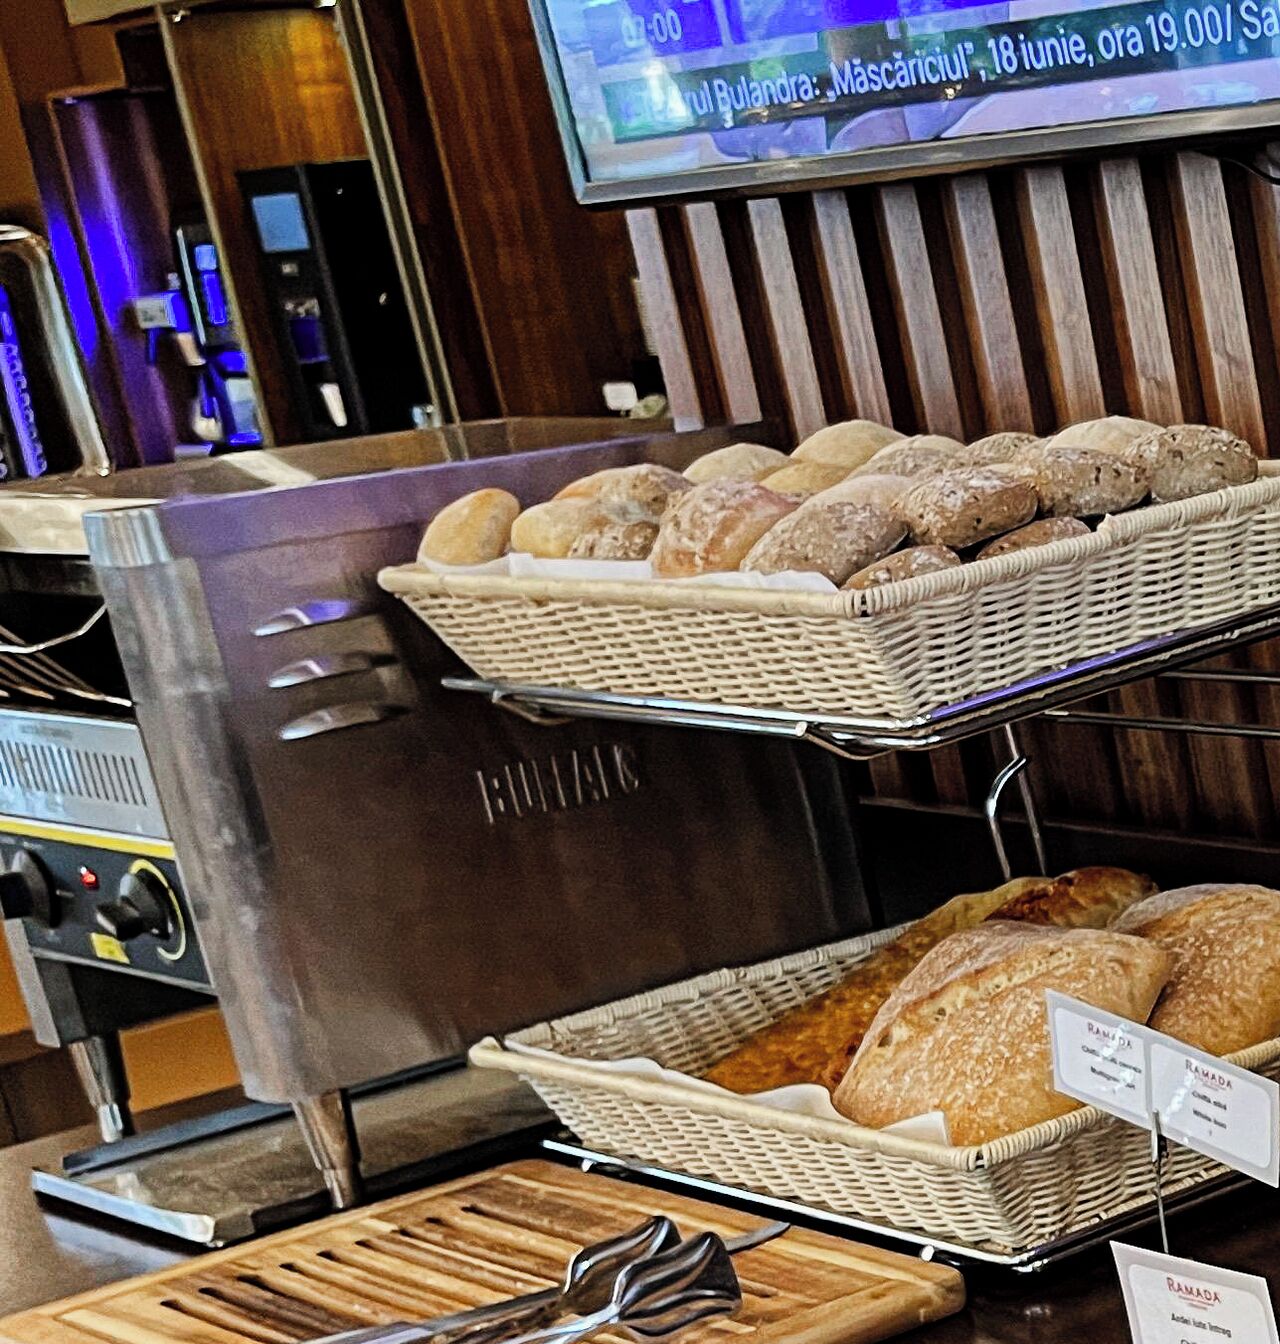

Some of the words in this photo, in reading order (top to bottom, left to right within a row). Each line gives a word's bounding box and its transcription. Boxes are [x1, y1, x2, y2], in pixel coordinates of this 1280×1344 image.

[988, 34, 1018, 74] 18
[1018, 24, 1094, 70] iunie,
[1098, 25, 1144, 60] ora
[1185, 1059, 1233, 1089] RAMADA
[1166, 1277, 1221, 1304] RAMADA
